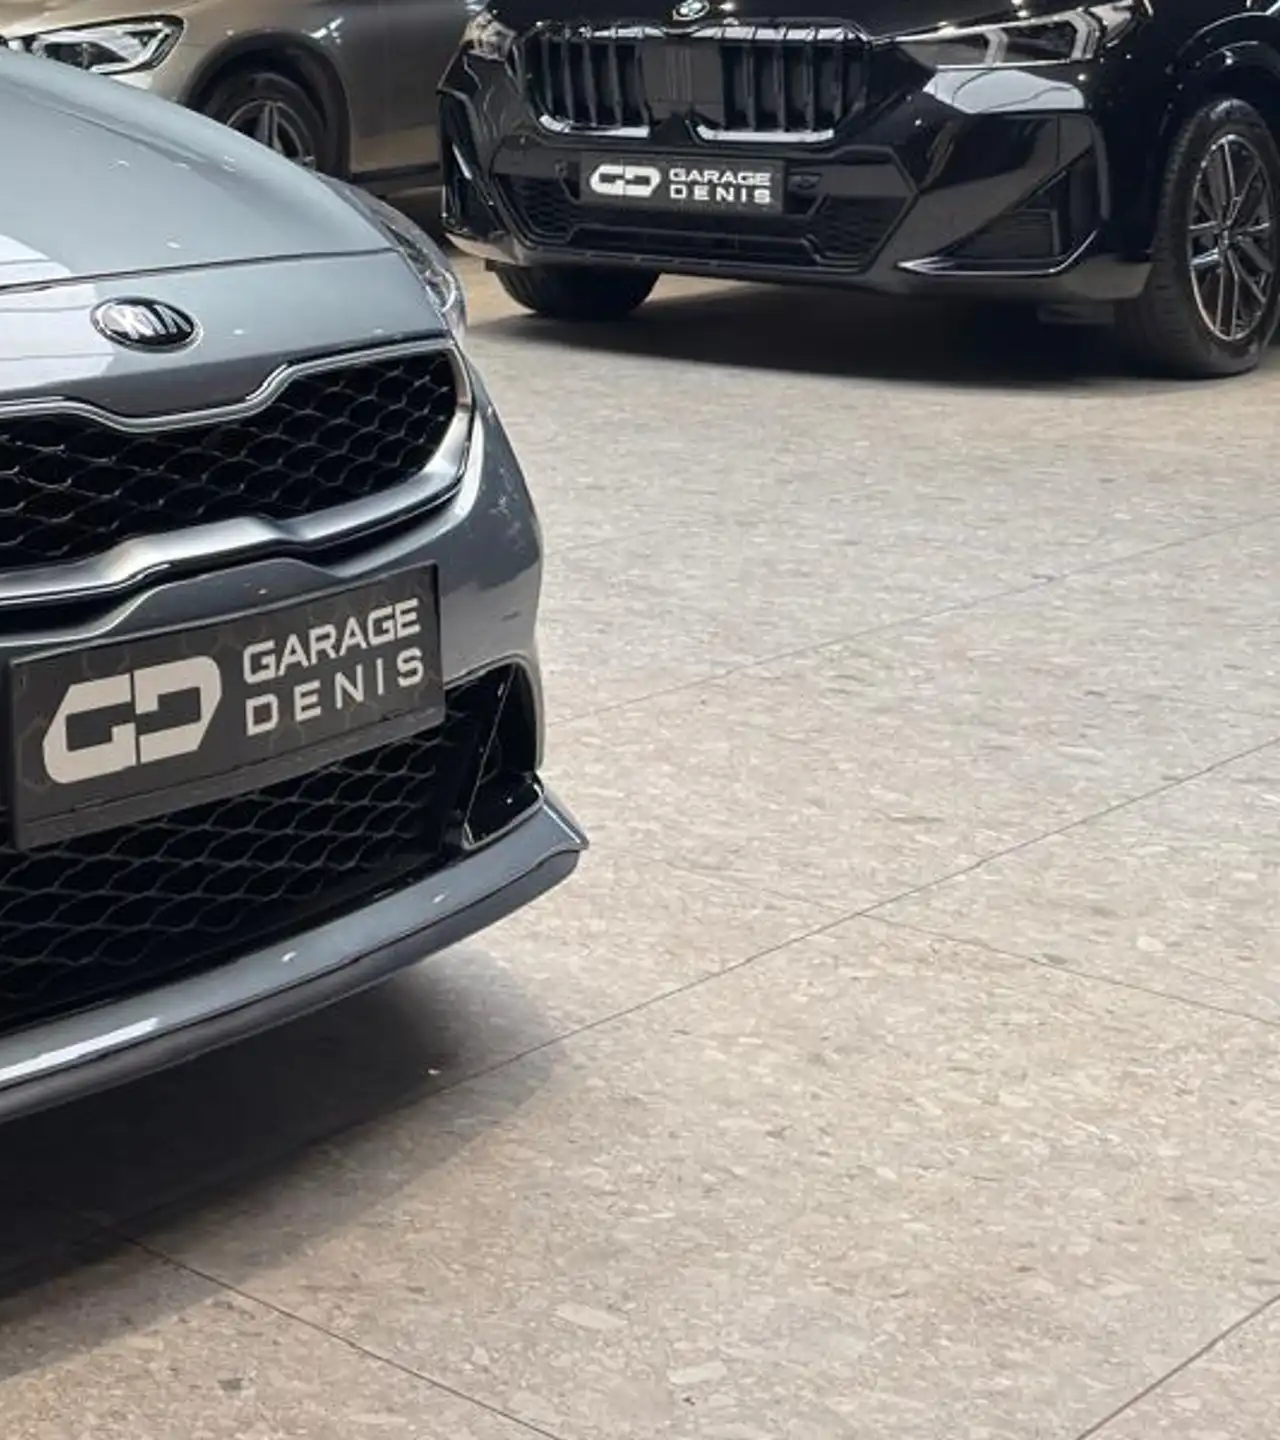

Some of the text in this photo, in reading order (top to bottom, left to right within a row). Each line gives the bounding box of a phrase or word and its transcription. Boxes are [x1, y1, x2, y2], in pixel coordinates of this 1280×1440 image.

[669, 168, 772, 186] GARAGE
[670, 184, 772, 204] DENIS
[108, 303, 192, 340] KIA
[243, 597, 422, 685] GARAGE
[245, 646, 424, 736] DENIS
